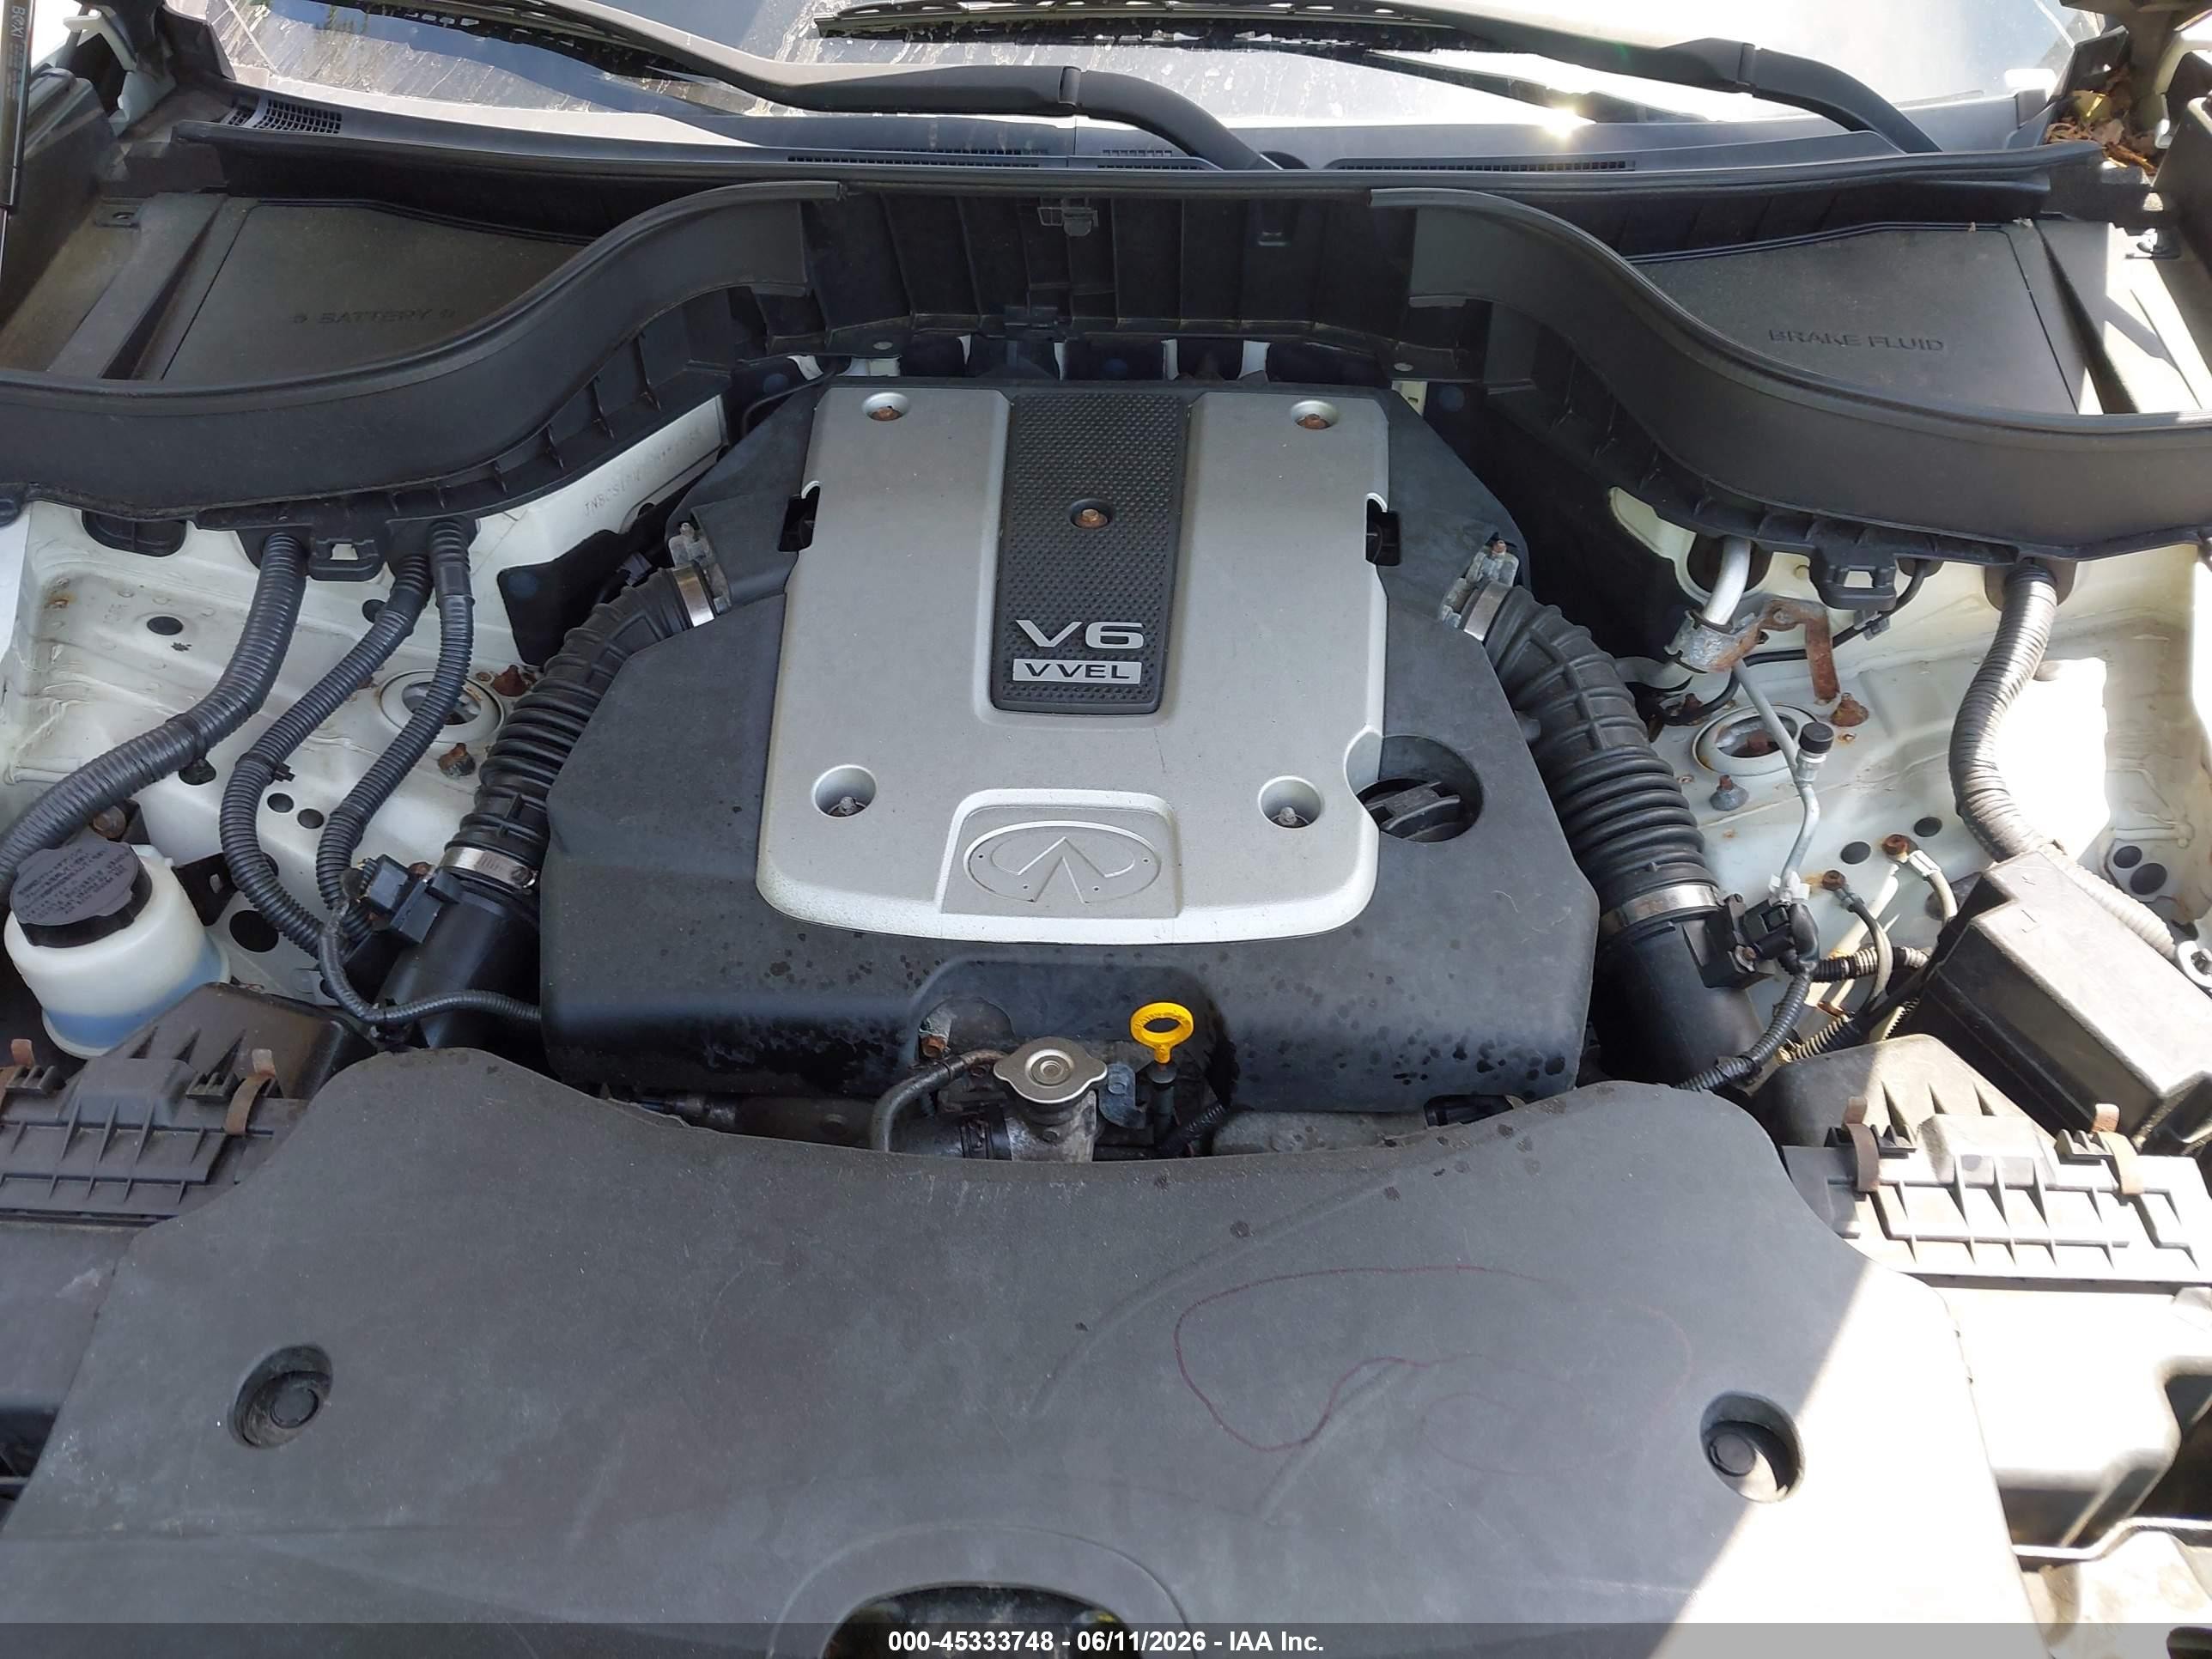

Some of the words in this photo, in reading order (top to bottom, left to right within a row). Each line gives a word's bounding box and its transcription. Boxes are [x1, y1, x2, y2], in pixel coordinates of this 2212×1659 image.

[318, 308, 433, 325] BATTERY
[1768, 329, 1863, 346] BRAKE
[1868, 335, 1944, 351] FLUID
[1015, 619, 1145, 649] V6
[1023, 662, 1130, 679] VVEL
